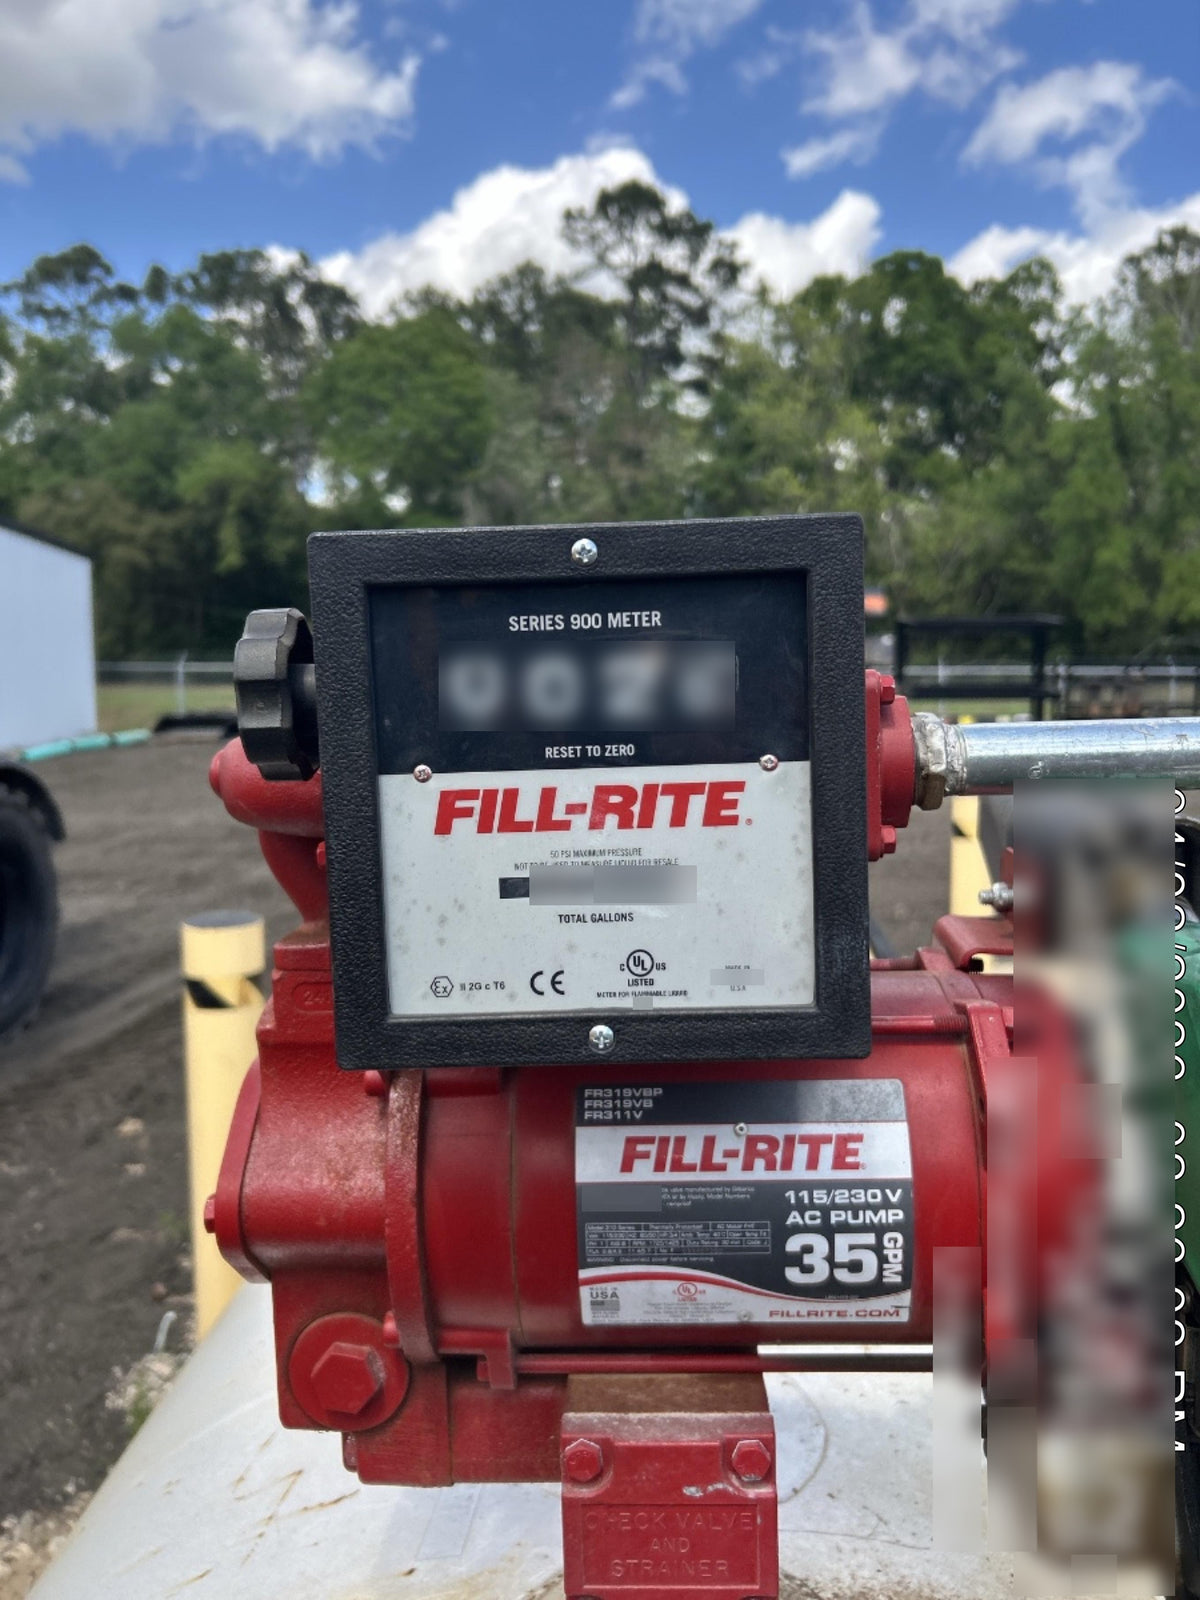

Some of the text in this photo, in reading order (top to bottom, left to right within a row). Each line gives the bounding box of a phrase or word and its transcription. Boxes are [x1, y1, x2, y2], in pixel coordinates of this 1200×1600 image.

[508, 611, 662, 631] SERIES 900 METER
[545, 744, 635, 759] RESET TO ZERO
[434, 780, 746, 835] FILL-RITE
[550, 850, 559, 858] 50
[573, 849, 606, 857] MAXIMUM
[608, 847, 642, 856] PRESSURE
[514, 862, 528, 871] NOT
[558, 912, 634, 924] TOTAL GALLONS
[656, 962, 666, 971] US
[469, 982, 482, 991] 2G
[493, 981, 506, 991] T6
[628, 978, 654, 987] LISTED
[584, 1087, 663, 1098] FR319VBP
[584, 1098, 653, 1109] FR319VB
[584, 1110, 643, 1120] FR311V
[620, 1133, 864, 1173] FILL-RITE
[784, 1188, 903, 1205] 115/230 V
[785, 1208, 904, 1225] AC PUMP
[784, 1232, 879, 1285] 35
[882, 1231, 904, 1283] GPM
[589, 1290, 620, 1300] USA
[769, 1308, 900, 1318] FILLRITE.COM
[584, 1511, 753, 1531] CHECK VALVE
[651, 1537, 690, 1553] AND
[611, 1559, 729, 1577] STRAINER
